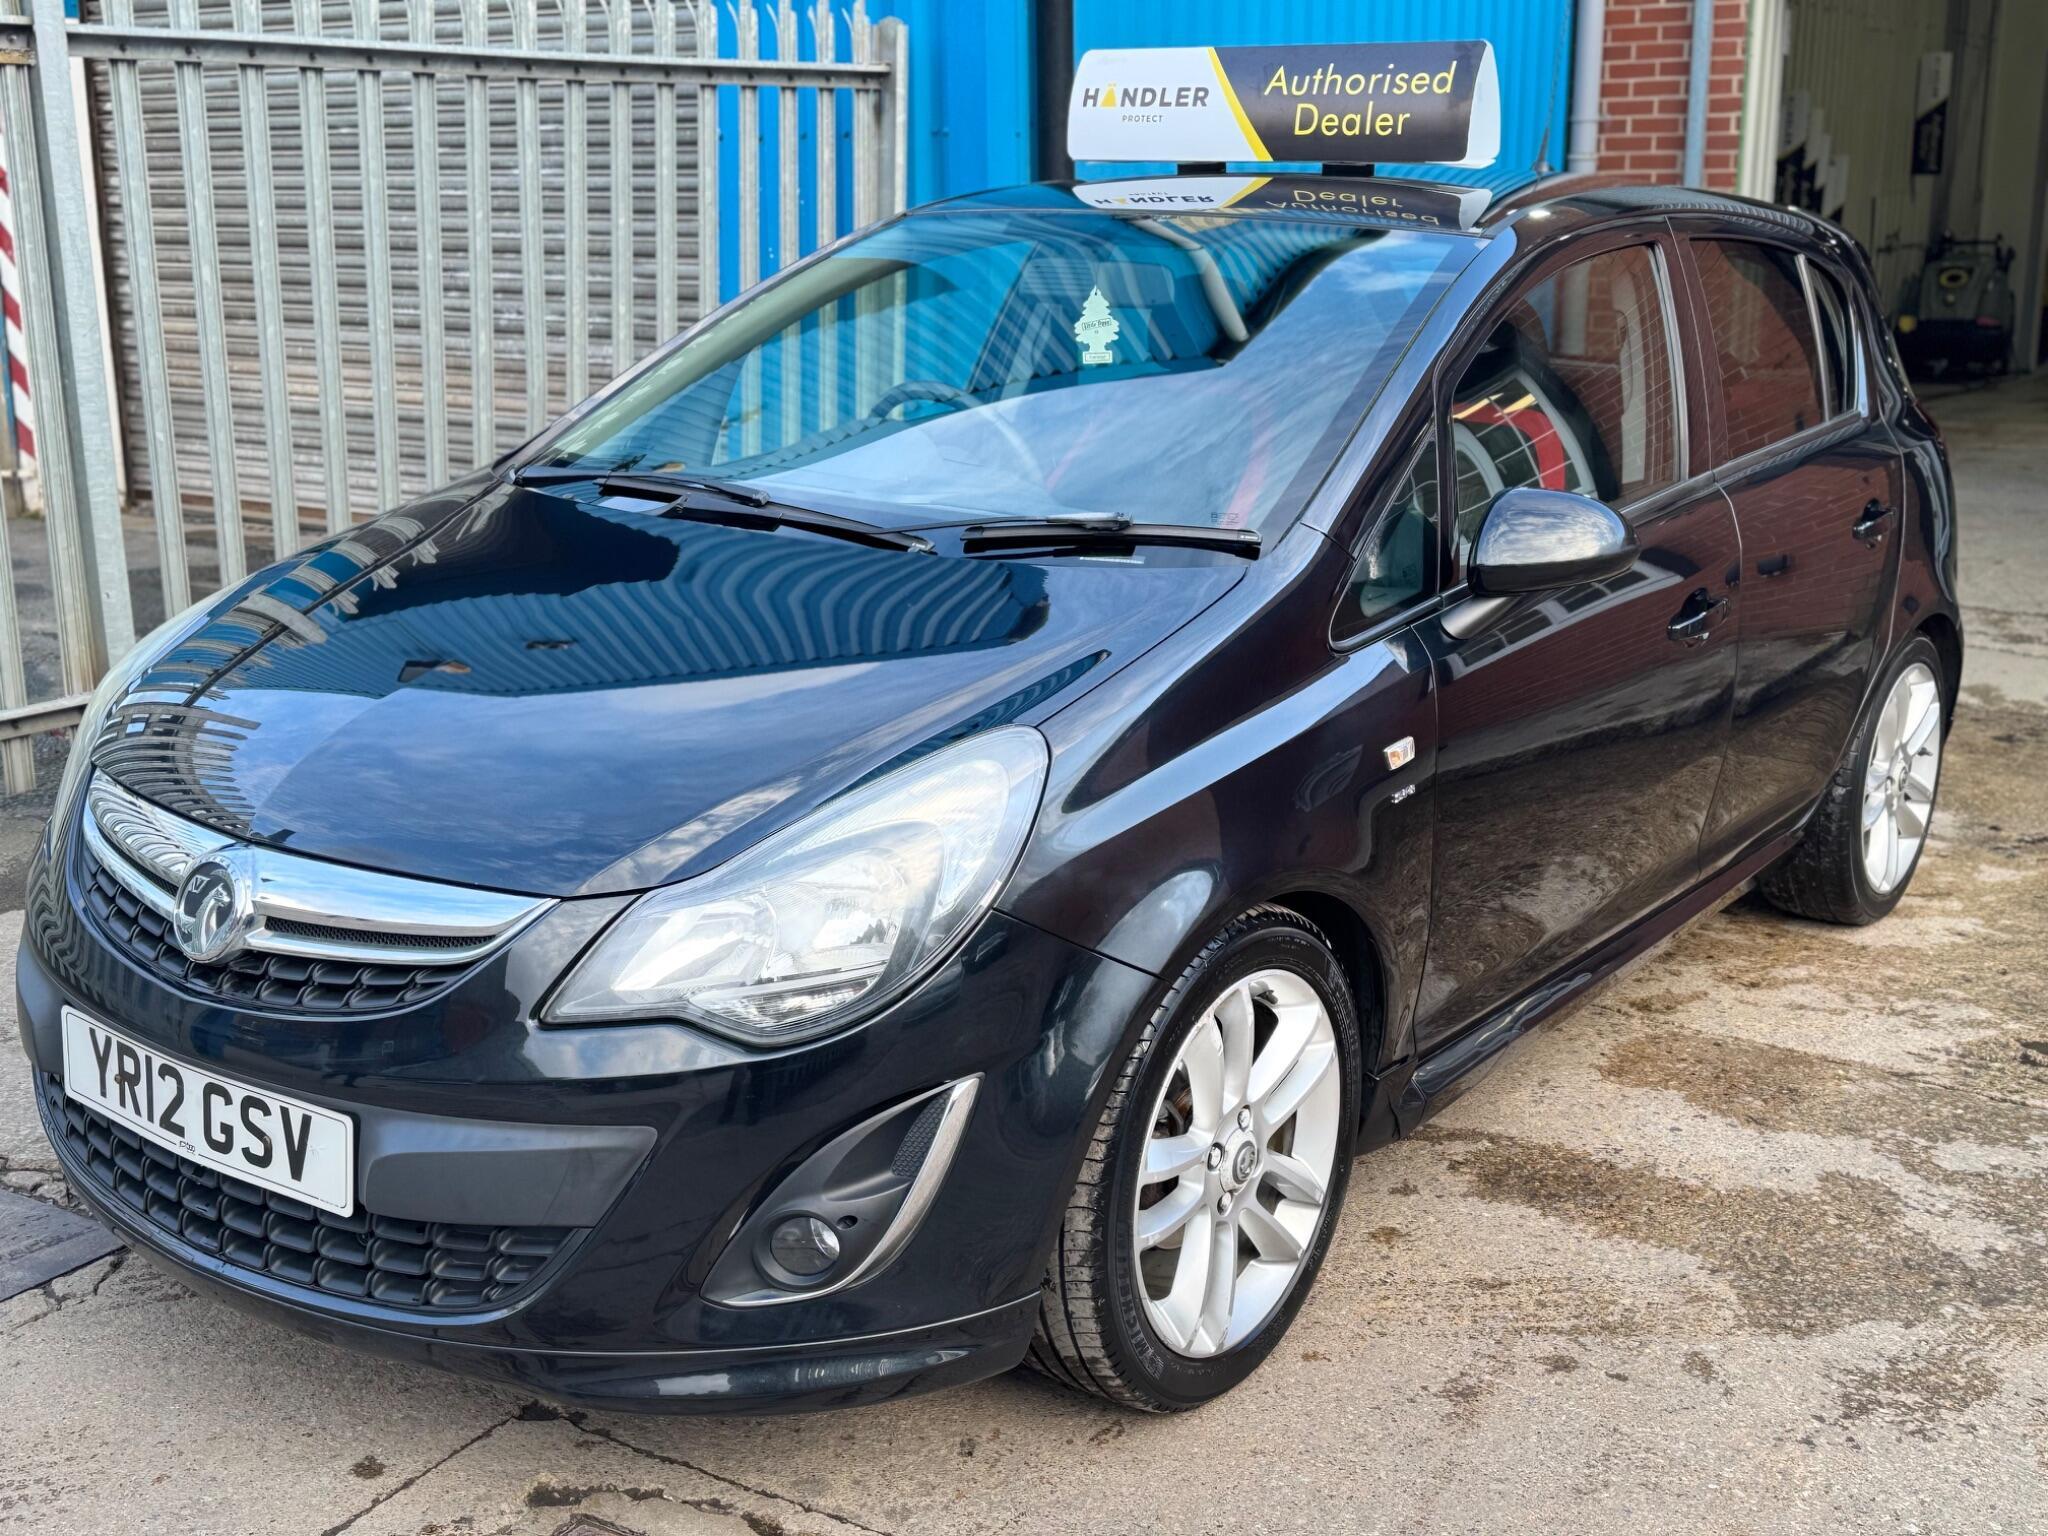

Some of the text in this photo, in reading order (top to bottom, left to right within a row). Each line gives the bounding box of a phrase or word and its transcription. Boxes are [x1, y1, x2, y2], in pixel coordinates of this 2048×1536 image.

[1264, 60, 1457, 95] Authorised
[1122, 114, 1163, 122] PROTECT
[1294, 100, 1411, 136] Dealer
[89, 1027, 313, 1183] YR12 GSV
